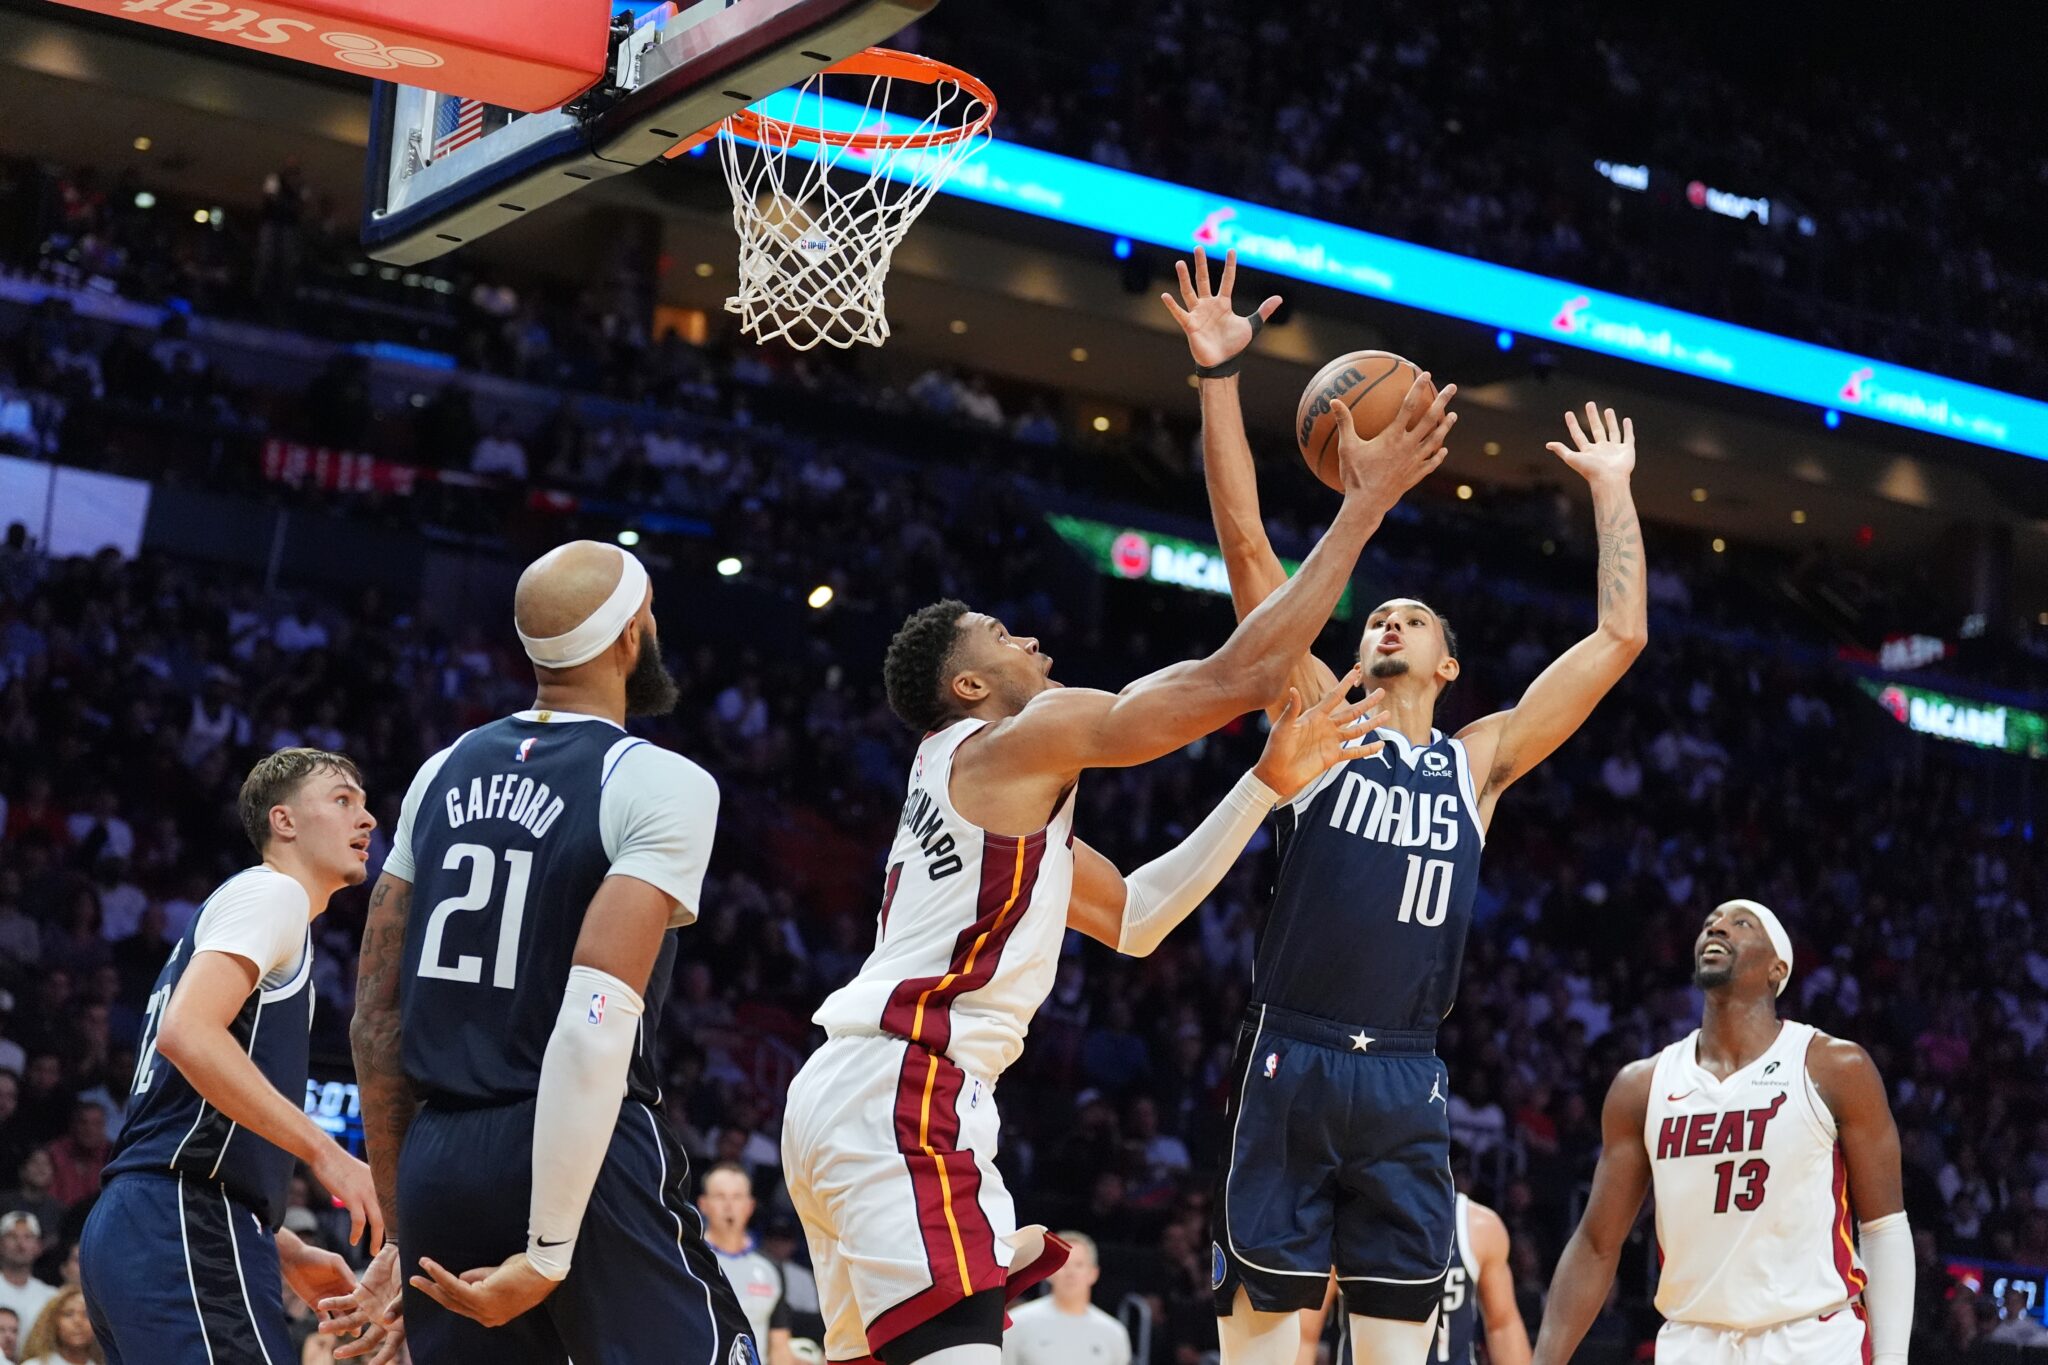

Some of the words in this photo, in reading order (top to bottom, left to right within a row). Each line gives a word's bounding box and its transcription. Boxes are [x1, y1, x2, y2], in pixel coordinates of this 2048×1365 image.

[446, 774, 564, 839] GAFFORD
[1422, 769, 1453, 778] CHASE
[417, 842, 533, 989] 21
[1397, 853, 1454, 927] 10
[1657, 1090, 1788, 1160] HEAT
[1714, 1158, 1771, 1214] 13
